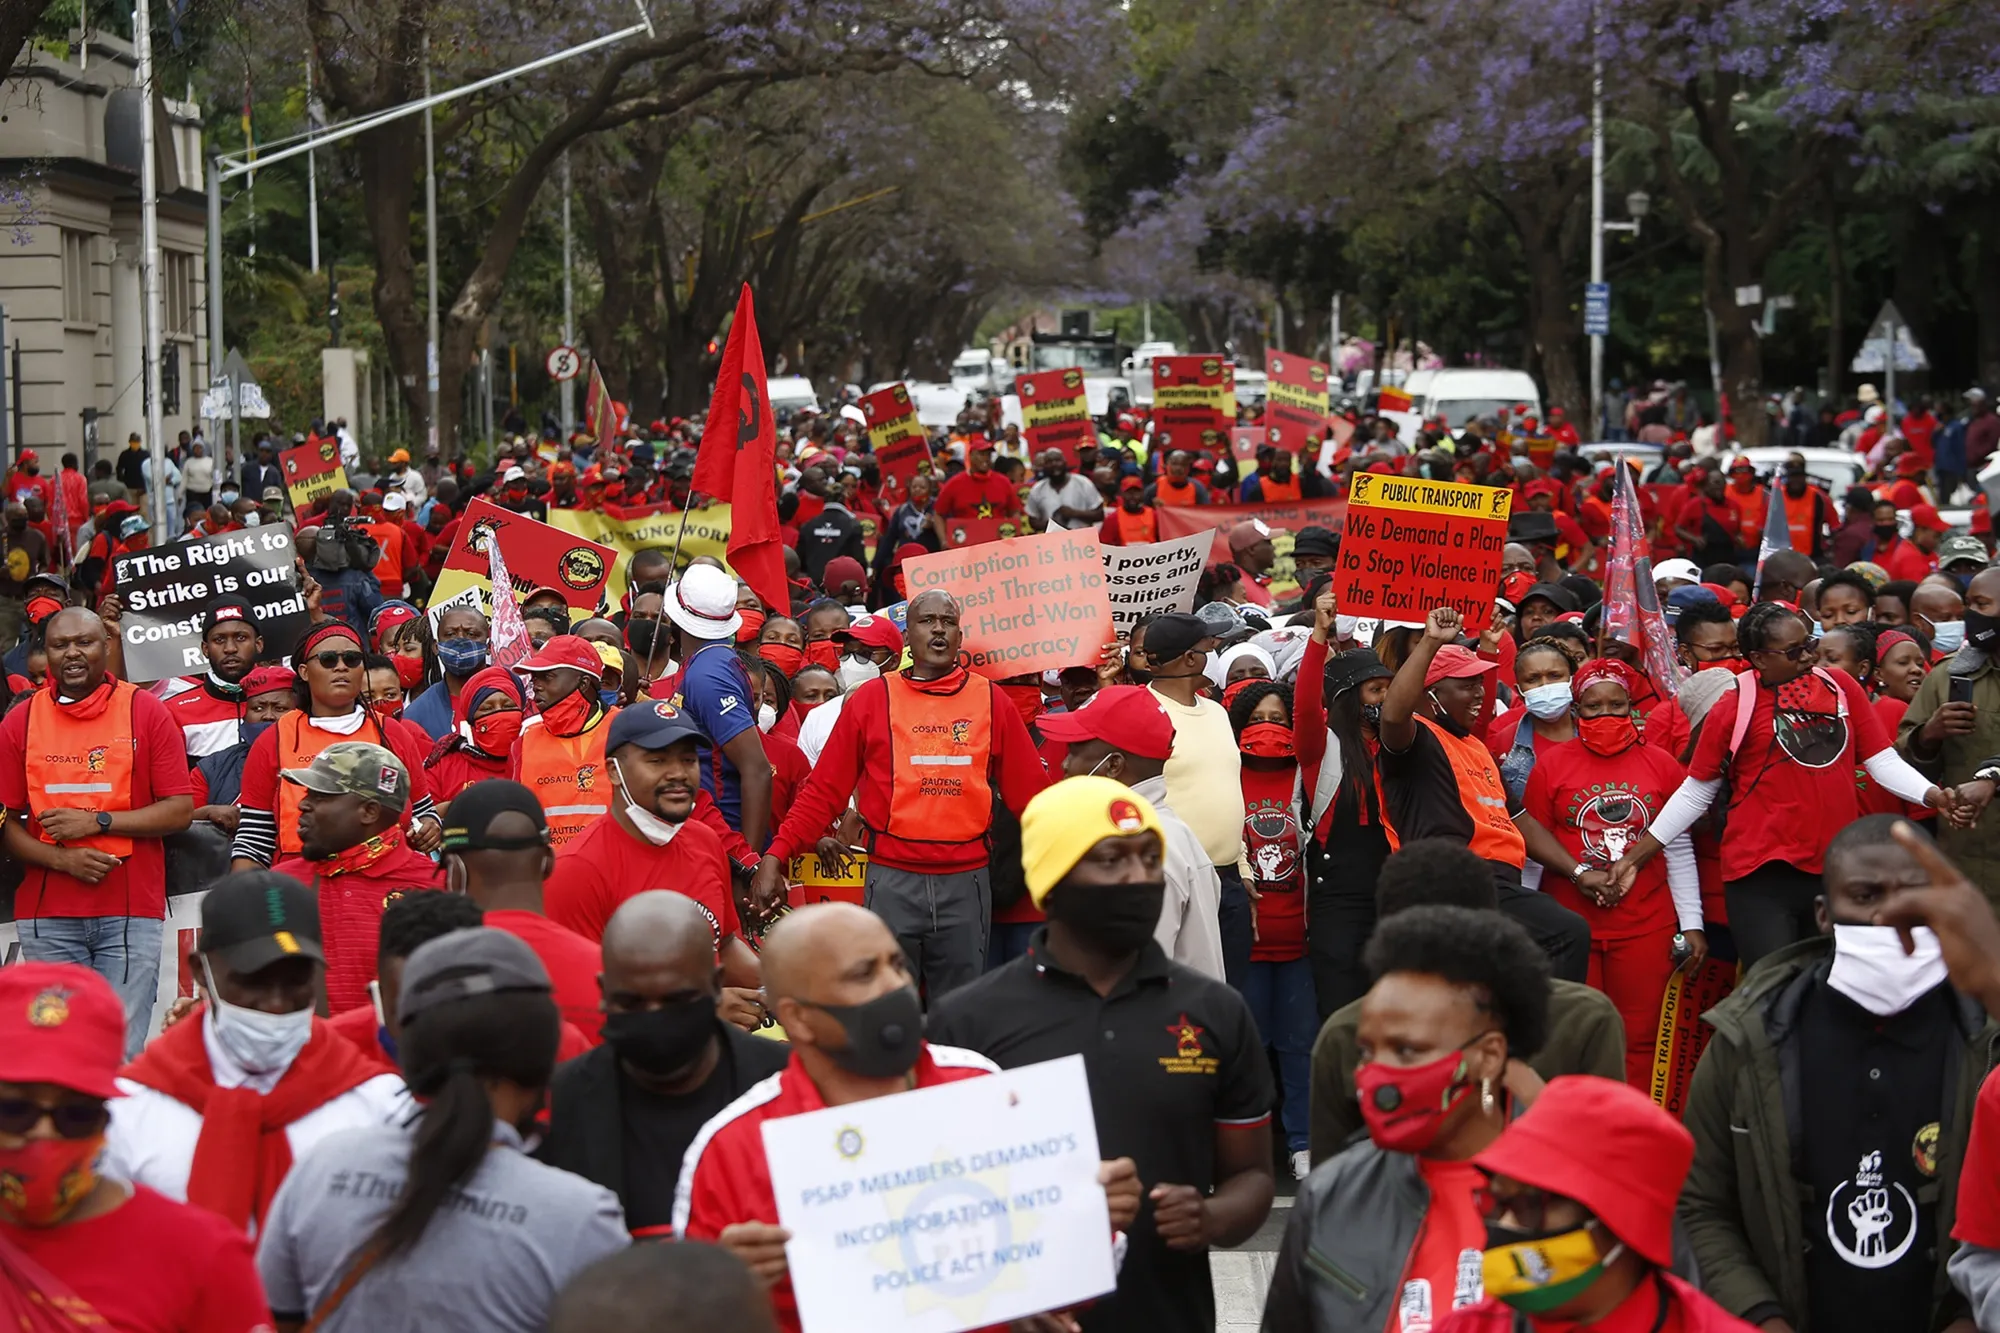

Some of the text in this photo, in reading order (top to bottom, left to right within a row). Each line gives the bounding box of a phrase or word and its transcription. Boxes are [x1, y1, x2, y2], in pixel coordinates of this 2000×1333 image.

[1350, 498, 1371, 506] COSATU
[1381, 482, 1419, 504] PUBLIC
[1421, 486, 1484, 511] TRANSPORT
[1347, 513, 1504, 552] We Demand a Plan
[131, 532, 289, 577] The Right to
[910, 550, 1030, 588] Corruption
[1037, 544, 1055, 564] is
[1061, 538, 1097, 562] the
[1105, 558, 1202, 586] osses and
[1118, 546, 1198, 571] poverty,
[1342, 548, 1498, 585] to Stop Violence in
[128, 564, 290, 611] Strike is our
[956, 570, 1102, 616] gest Threat to
[1108, 584, 1186, 603] ualities.
[1346, 577, 1488, 624] the Taxi Industry
[980, 600, 1097, 637] Hard-Won
[955, 635, 1080, 670] Democracy
[912, 725, 949, 734] COSATU
[45, 754, 84, 765] COSATU
[537, 775, 573, 786] COSATU
[920, 788, 962, 797] PROVINCE
[921, 778, 962, 787] GAUTENG
[1566, 781, 1640, 827] NATIONAL
[1658, 983, 1679, 1065] TRANSPORT
[1669, 1026, 1691, 1114] Demand
[1683, 1007, 1692, 1020] a
[801, 1133, 1079, 1207] PSAP MEMBERS DEMAND'S
[834, 1184, 1063, 1248] INCORPORATION INTO
[872, 1240, 1045, 1293] POLICE ACT NOW
